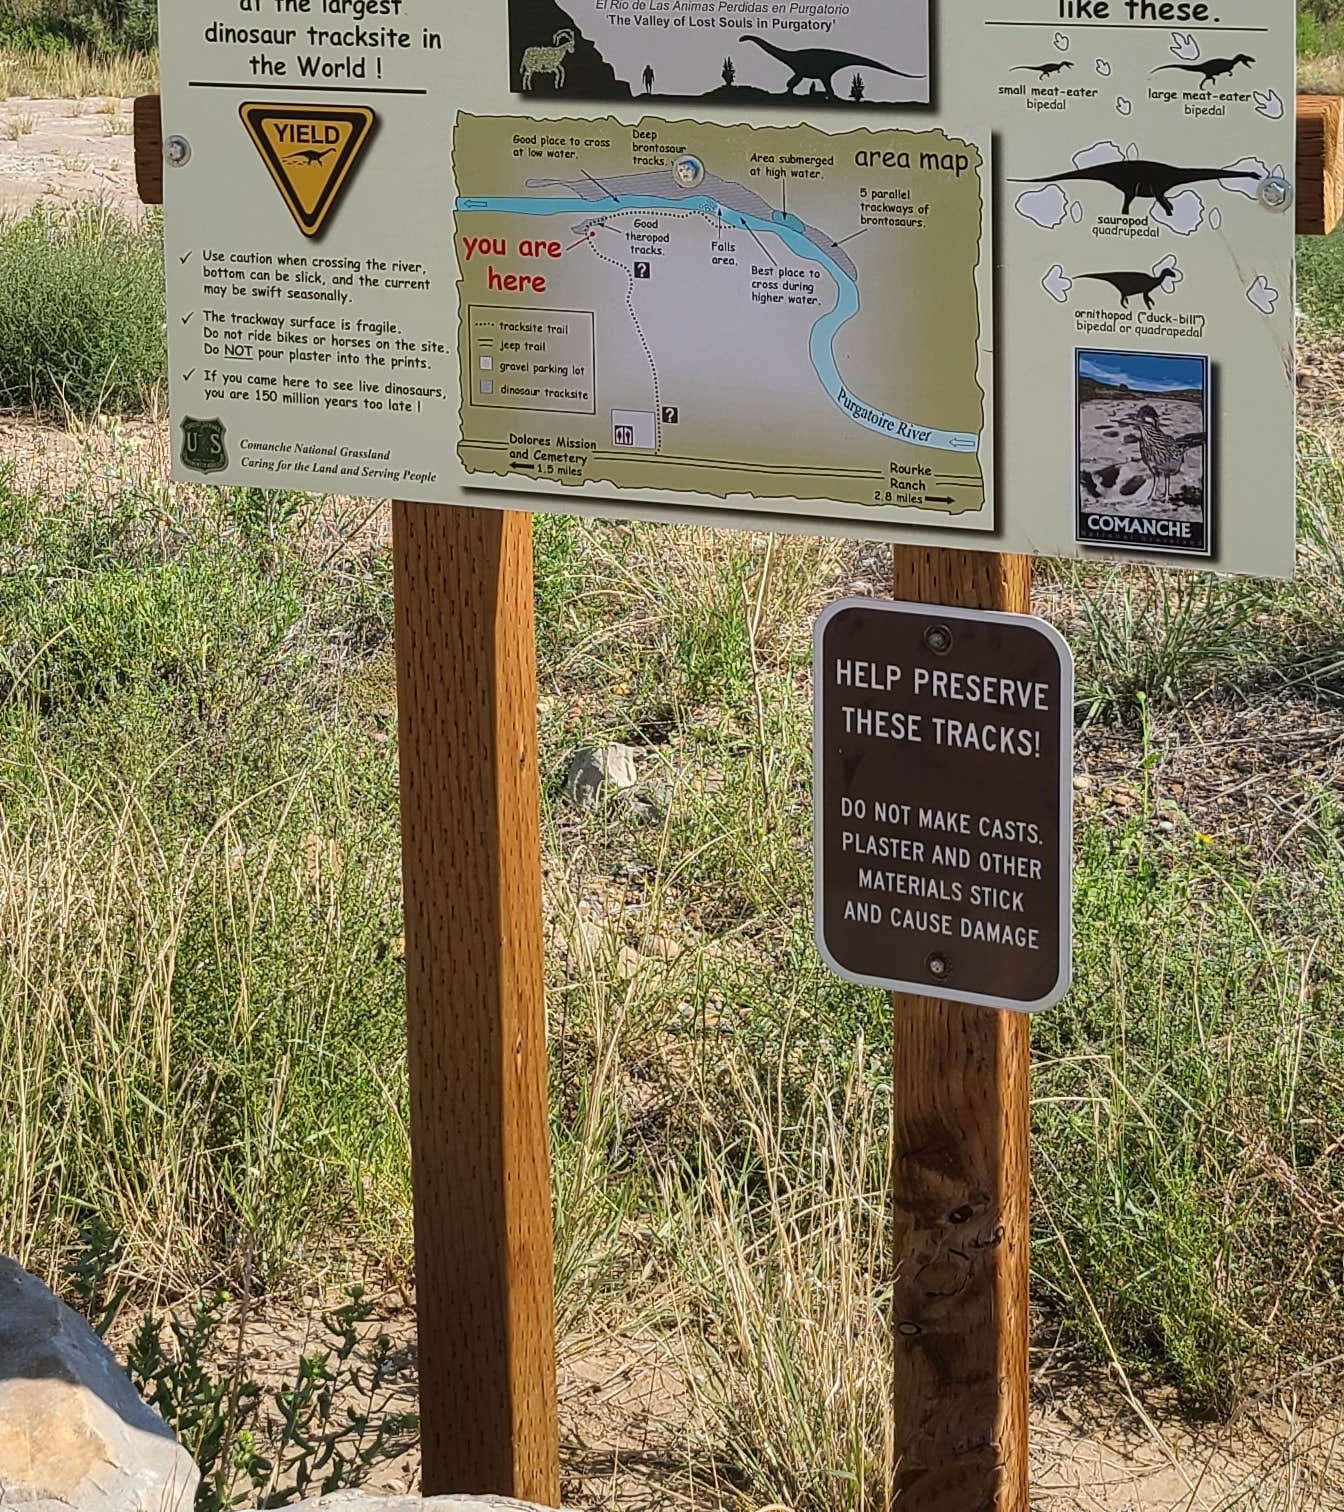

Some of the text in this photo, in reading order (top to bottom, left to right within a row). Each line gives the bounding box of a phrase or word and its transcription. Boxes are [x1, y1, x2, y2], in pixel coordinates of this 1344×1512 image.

[204, 21, 442, 49] dinosaur tracksite in
[605, 14, 836, 33] 'The Valley of Lost Souls in Purgatory'
[248, 54, 286, 76] the
[296, 56, 365, 78] World
[997, 84, 1098, 97] small meat-eater
[1026, 98, 1066, 112] bipedal
[273, 124, 340, 144] YIELD
[632, 129, 657, 142] Deep
[854, 151, 968, 178] area map
[1096, 216, 1149, 228] sauropod
[460, 237, 562, 260] you are
[202, 250, 426, 275] Use caution when crossing the river,
[202, 265, 430, 290] bottom can be slick, and the current
[486, 267, 545, 294] here
[203, 284, 352, 305] may be swift seasonally.
[498, 322, 568, 335] tracksite trail
[499, 340, 546, 352] jeep trail
[837, 386, 933, 442] Purgatoire River
[239, 439, 391, 460] Comanche National Grassland
[890, 462, 932, 475] Rourke
[890, 479, 926, 491] Ranch
[1087, 515, 1192, 538] COMANCHE
[836, 659, 1049, 711] HELP PRESERVE
[841, 706, 1040, 758] THESE TRACKS!
[841, 797, 1043, 845] DO NOT MAKE CASTS.
[842, 832, 1042, 880] PLASTER AND OTHER
[858, 868, 1024, 912] MATERIALS STICK
[843, 901, 1039, 949] AND CAUSE DAMAGE
